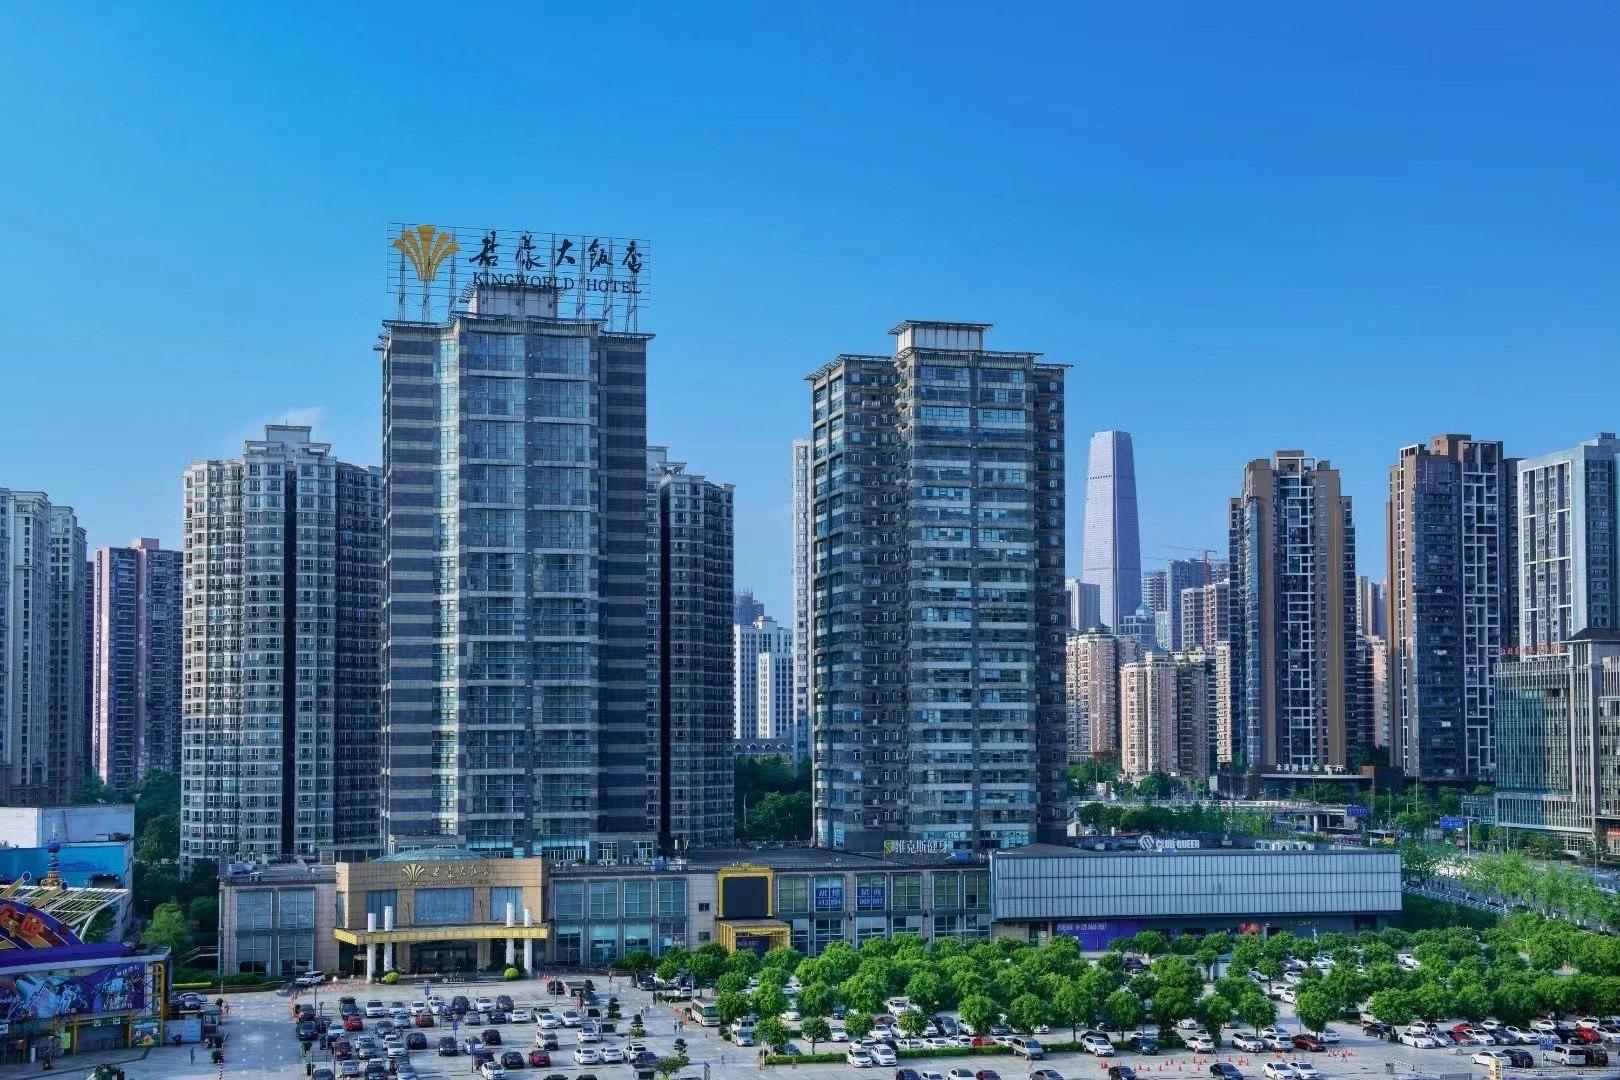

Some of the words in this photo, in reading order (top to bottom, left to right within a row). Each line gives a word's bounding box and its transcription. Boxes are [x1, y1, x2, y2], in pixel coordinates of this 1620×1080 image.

[472, 271, 574, 290] KINGWORLD
[586, 278, 642, 294] HOTEL
[895, 839, 948, 854] 维克斯健身
[1155, 839, 1176, 849] CLUB
[1176, 839, 1200, 849] QUEEN
